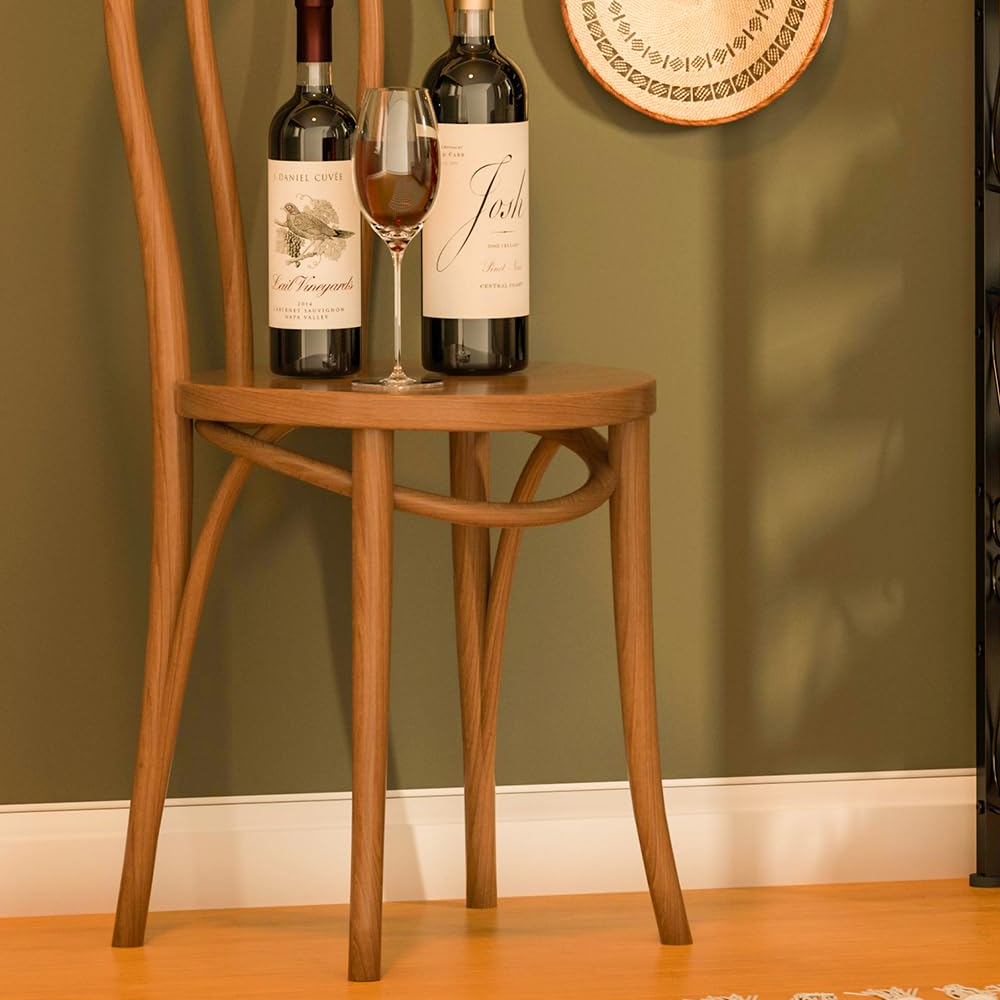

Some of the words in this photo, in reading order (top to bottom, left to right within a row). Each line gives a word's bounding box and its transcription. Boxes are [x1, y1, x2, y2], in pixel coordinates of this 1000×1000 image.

[278, 172, 309, 182] DANIEL
[314, 172, 343, 182] CUVÉE
[436, 154, 526, 273] Josh
[295, 275, 353, 297] Vineyards
